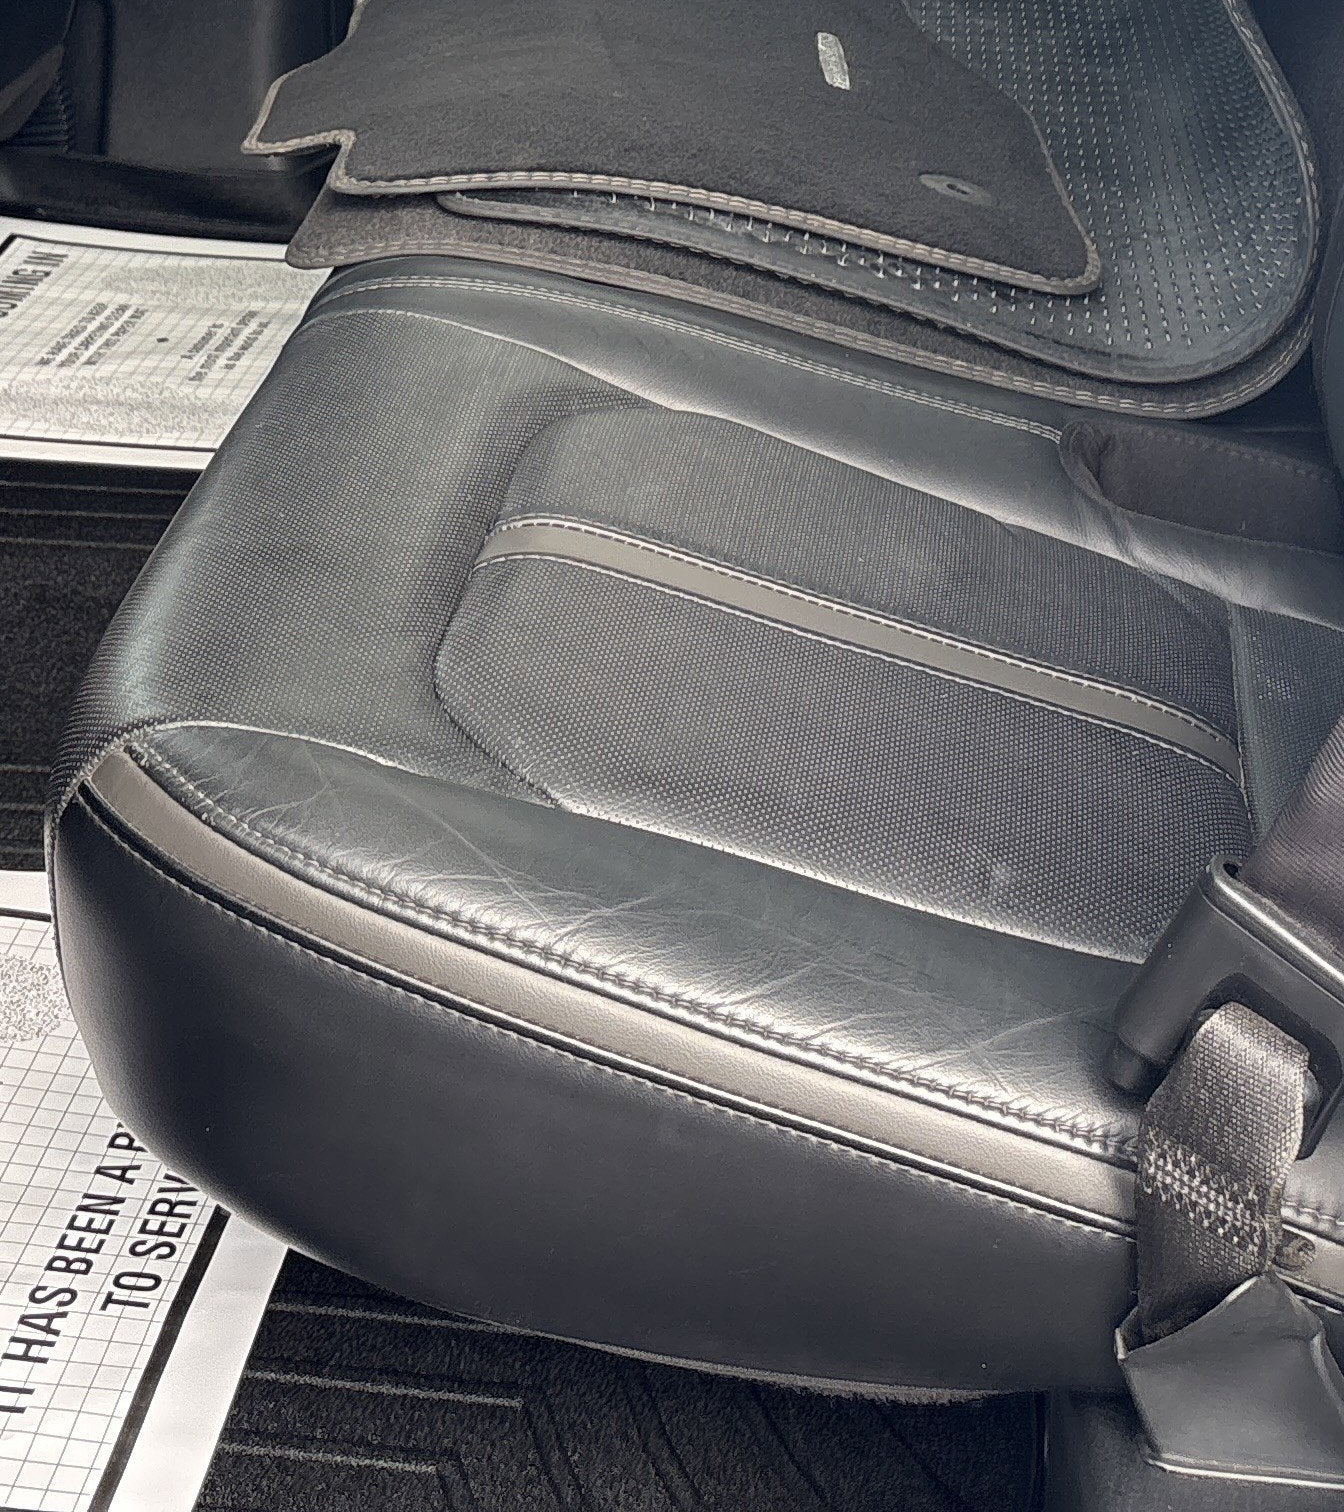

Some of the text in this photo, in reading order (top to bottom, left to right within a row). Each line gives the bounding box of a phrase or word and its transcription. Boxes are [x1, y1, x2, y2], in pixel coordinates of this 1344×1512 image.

[23, 250, 69, 267] IN
[1, 1285, 78, 1364] HAS
[44, 1192, 127, 1276] BEEN
[94, 1164, 142, 1185] A
[99, 1172, 200, 1311] TO SERV
